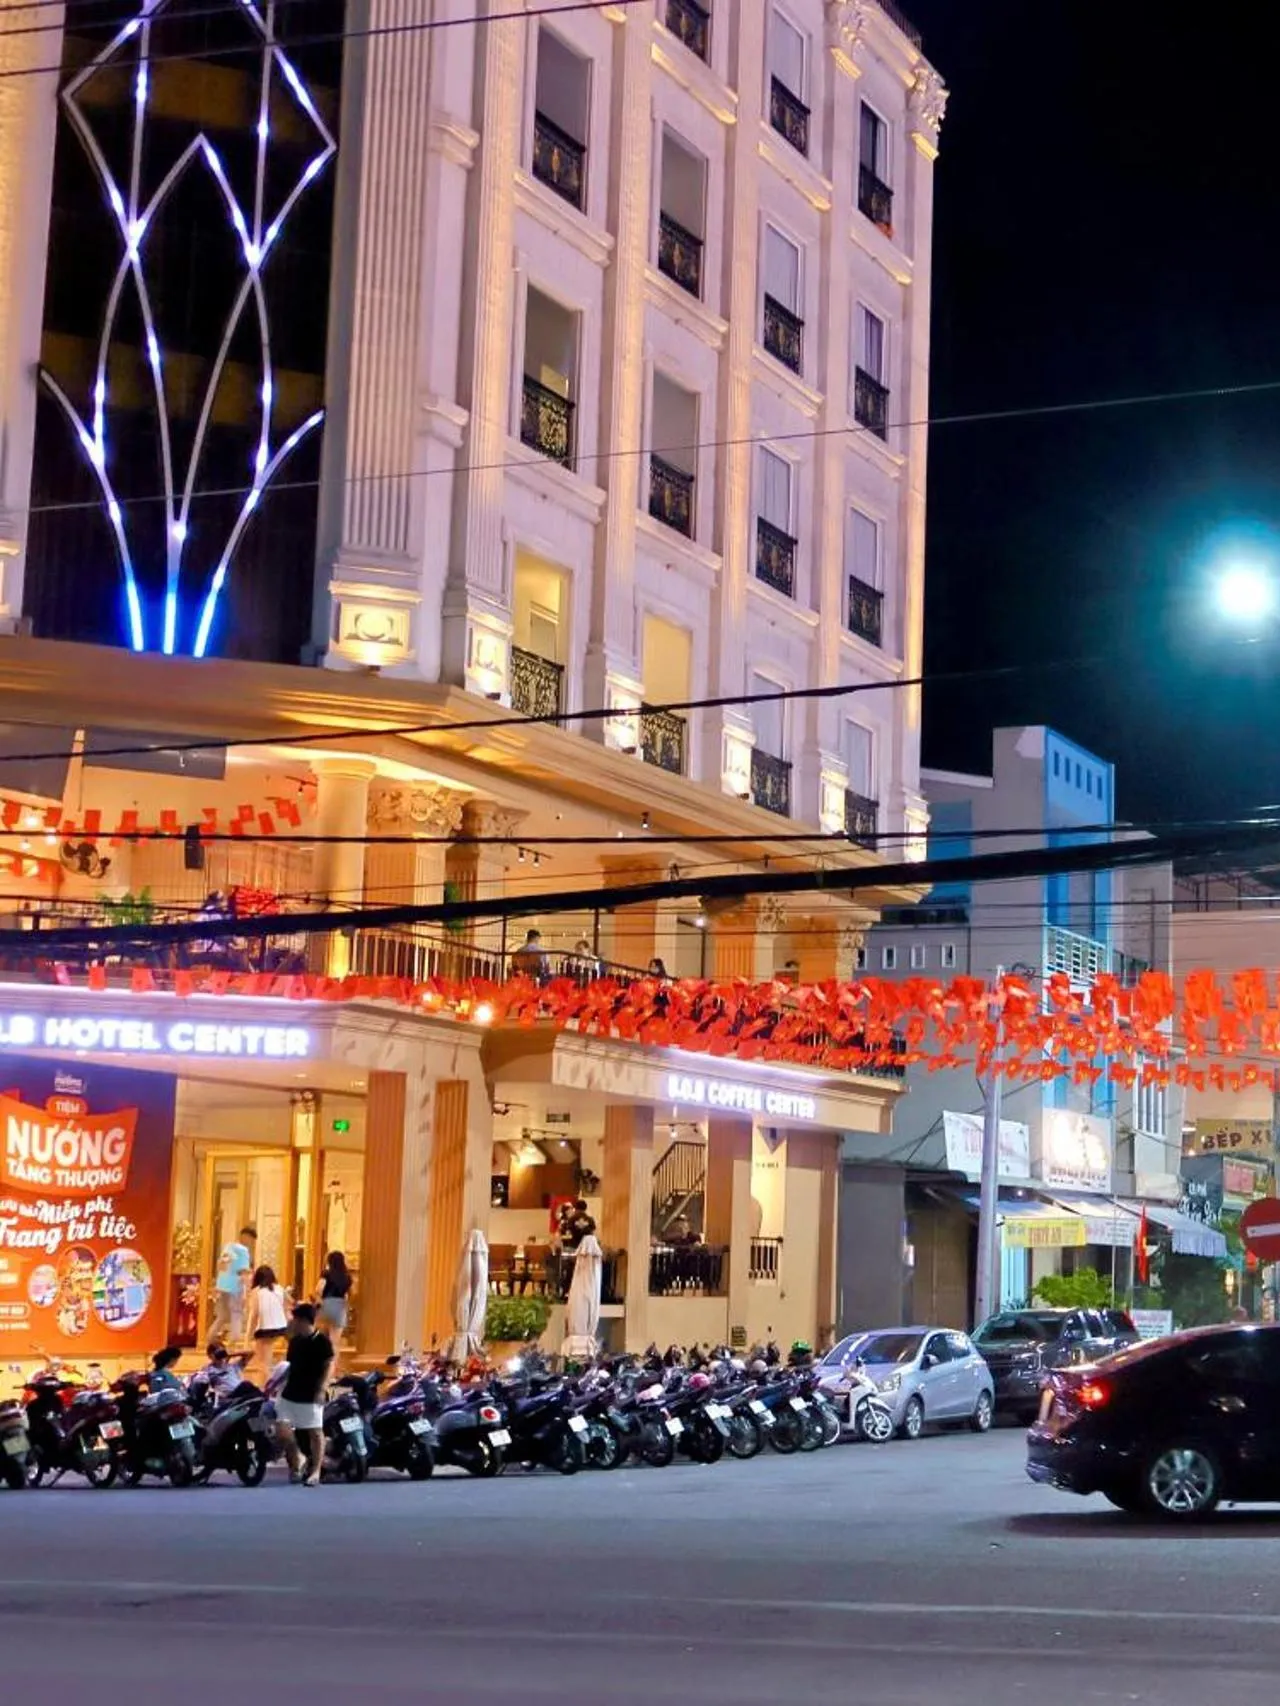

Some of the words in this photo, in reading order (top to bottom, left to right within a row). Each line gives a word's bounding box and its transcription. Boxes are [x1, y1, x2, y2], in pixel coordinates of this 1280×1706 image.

[45, 1018, 161, 1049] HOTEL
[167, 1022, 310, 1056] CENTER
[708, 1081, 762, 1111] COFFEE
[766, 1091, 816, 1119] CENTER
[7, 1115, 126, 1167] NƯỚNG
[99, 1216, 137, 1244] tiệc
